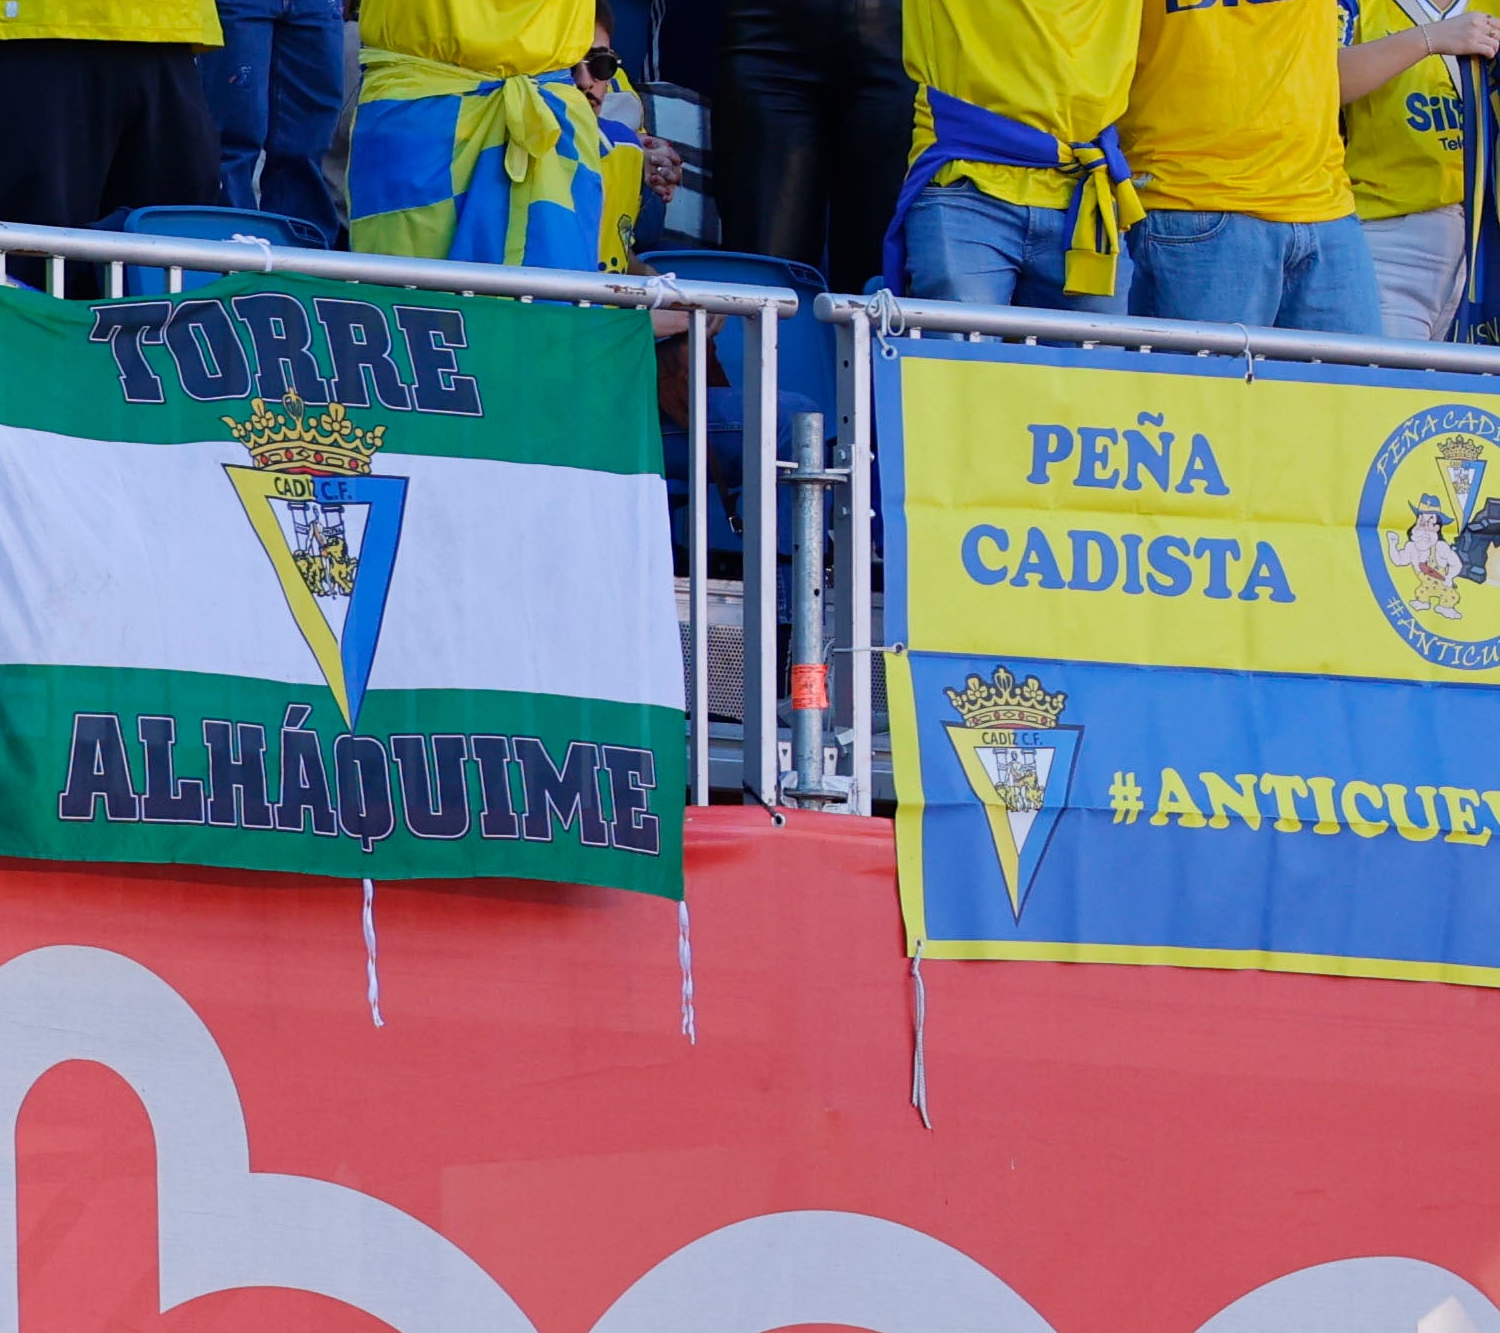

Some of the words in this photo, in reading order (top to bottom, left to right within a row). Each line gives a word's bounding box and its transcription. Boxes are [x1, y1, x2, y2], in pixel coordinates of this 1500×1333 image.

[87, 292, 484, 417] TORRE
[1025, 412, 1230, 496] PEÑA
[1376, 414, 1438, 485] PEÑA
[274, 477, 317, 502] CADIZ
[322, 480, 355, 503] C.F.
[961, 524, 1298, 604] CADISTA
[981, 731, 1018, 747] CADIZ
[1020, 732, 1044, 747] C.F.
[58, 703, 660, 856] ALHÁQUIME
